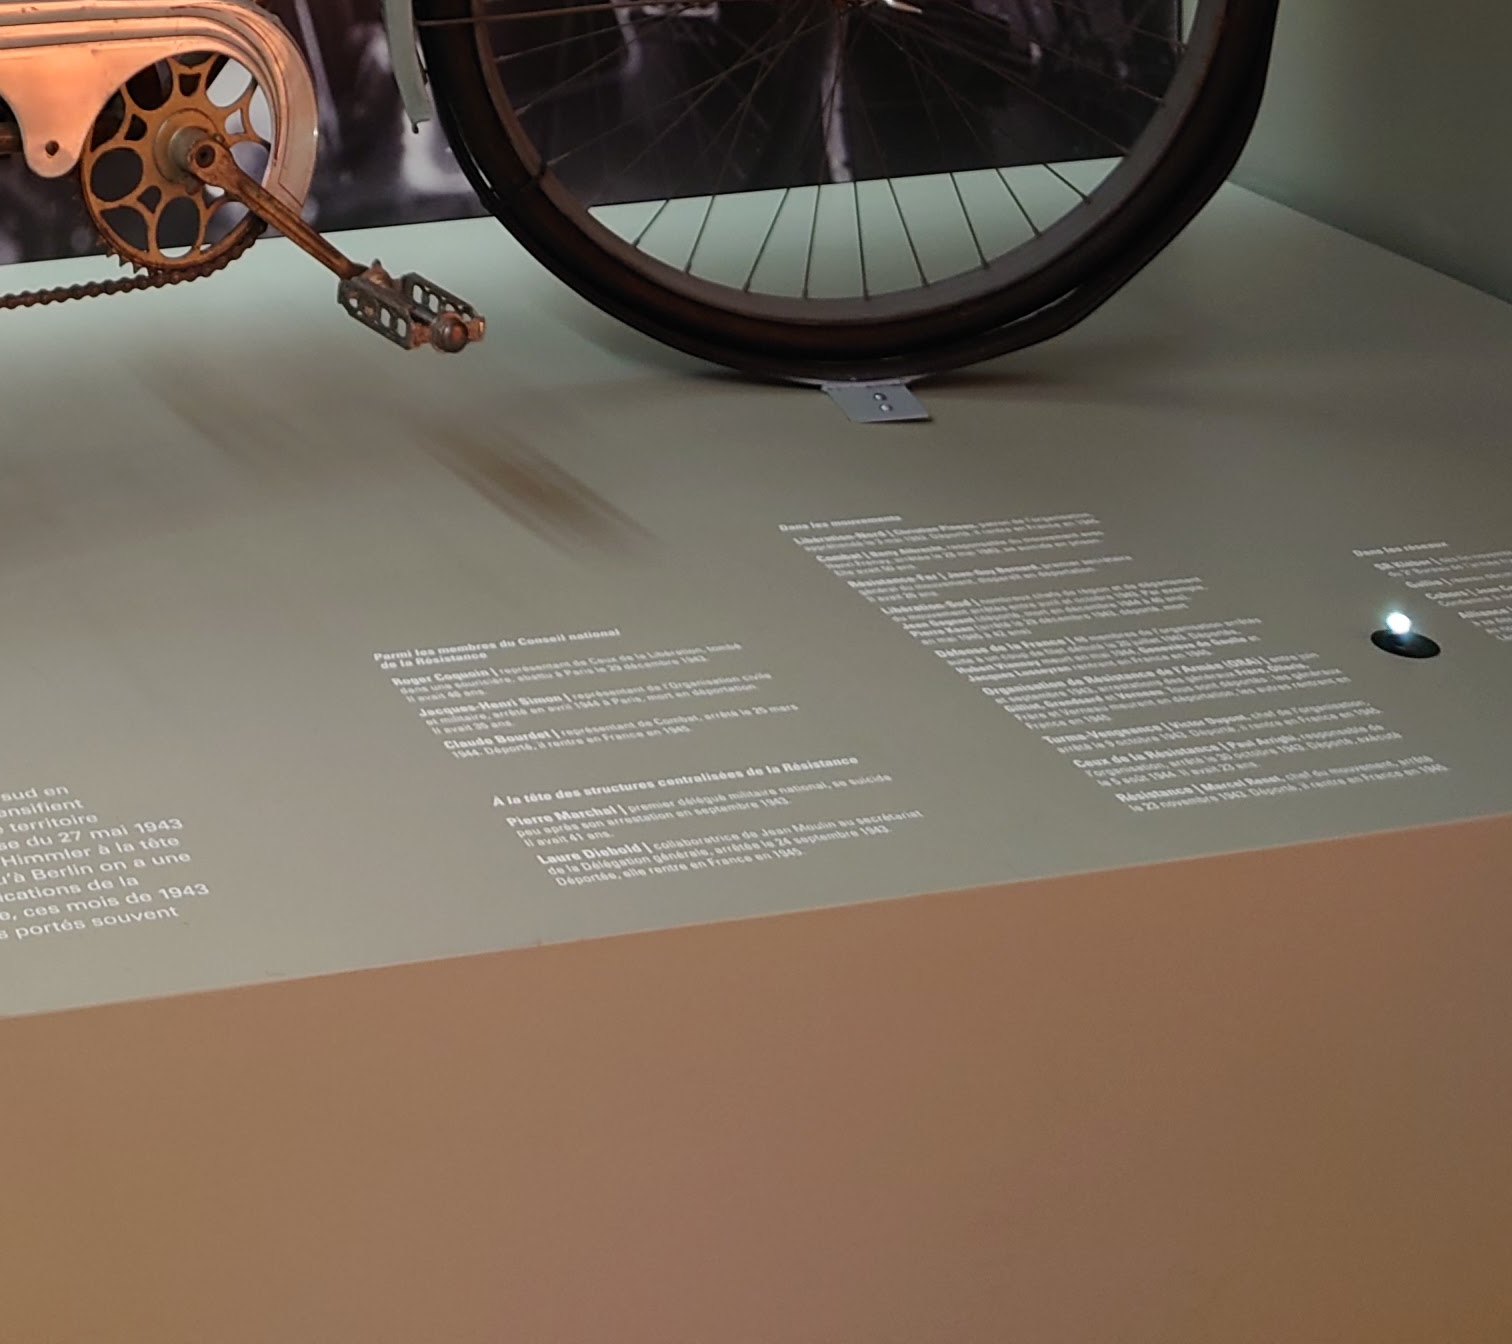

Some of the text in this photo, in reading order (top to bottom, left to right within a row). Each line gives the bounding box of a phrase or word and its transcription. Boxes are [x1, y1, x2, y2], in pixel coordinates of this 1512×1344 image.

[373, 628, 620, 661] Parmi les membres du Conseil national
[380, 652, 488, 669] de la Résistance
[493, 757, 858, 807] À la tête des structures centralisées de la Résistance
[0, 787, 38, 802] sud
[43, 786, 69, 796] en
[8, 814, 98, 832] territoire
[505, 804, 618, 827] Pierre Marchal
[25, 835, 53, 847] du
[57, 830, 81, 843] 27
[89, 824, 128, 839] mai
[133, 818, 183, 834] 1943
[98, 844, 110, 855] à
[114, 841, 135, 853] la
[138, 837, 179, 850] tête
[536, 842, 643, 865] Laure Diebold
[30, 863, 94, 881] Berlin
[99, 861, 127, 872] on
[133, 858, 146, 868] a
[151, 853, 191, 865] une
[86, 878, 114, 891] de
[118, 875, 139, 887] la
[23, 904, 60, 917] ces
[65, 895, 120, 912] mois
[125, 891, 152, 904] de
[157, 883, 209, 900] 1943
[14, 918, 86, 940] portés
[91, 906, 179, 927] souvent
